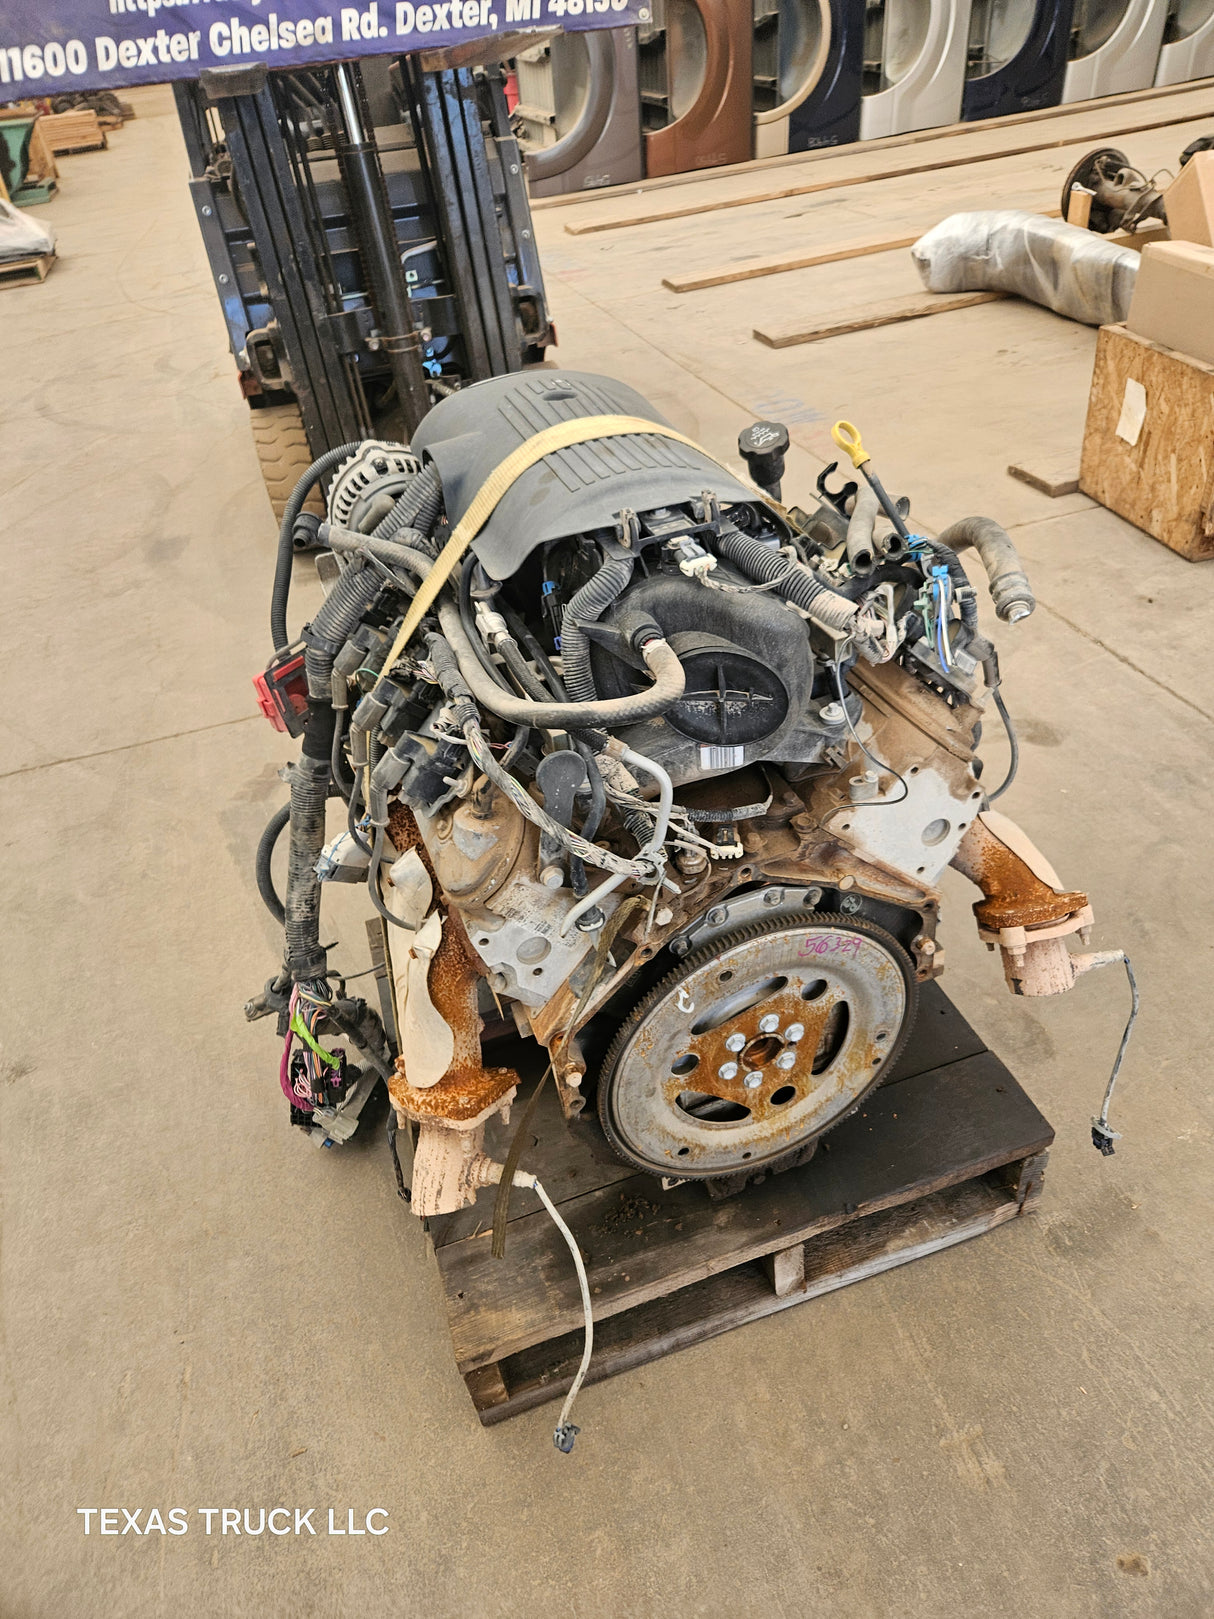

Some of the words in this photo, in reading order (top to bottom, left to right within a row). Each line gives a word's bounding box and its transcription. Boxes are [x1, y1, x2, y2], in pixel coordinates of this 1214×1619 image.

[95, 29, 201, 71] Dexter
[209, 13, 333, 56] Chelsea
[341, 2, 388, 41] Rd.
[395, 0, 498, 35] Dexter,
[505, 0, 541, 22] MI
[798, 935, 863, 960] 56329
